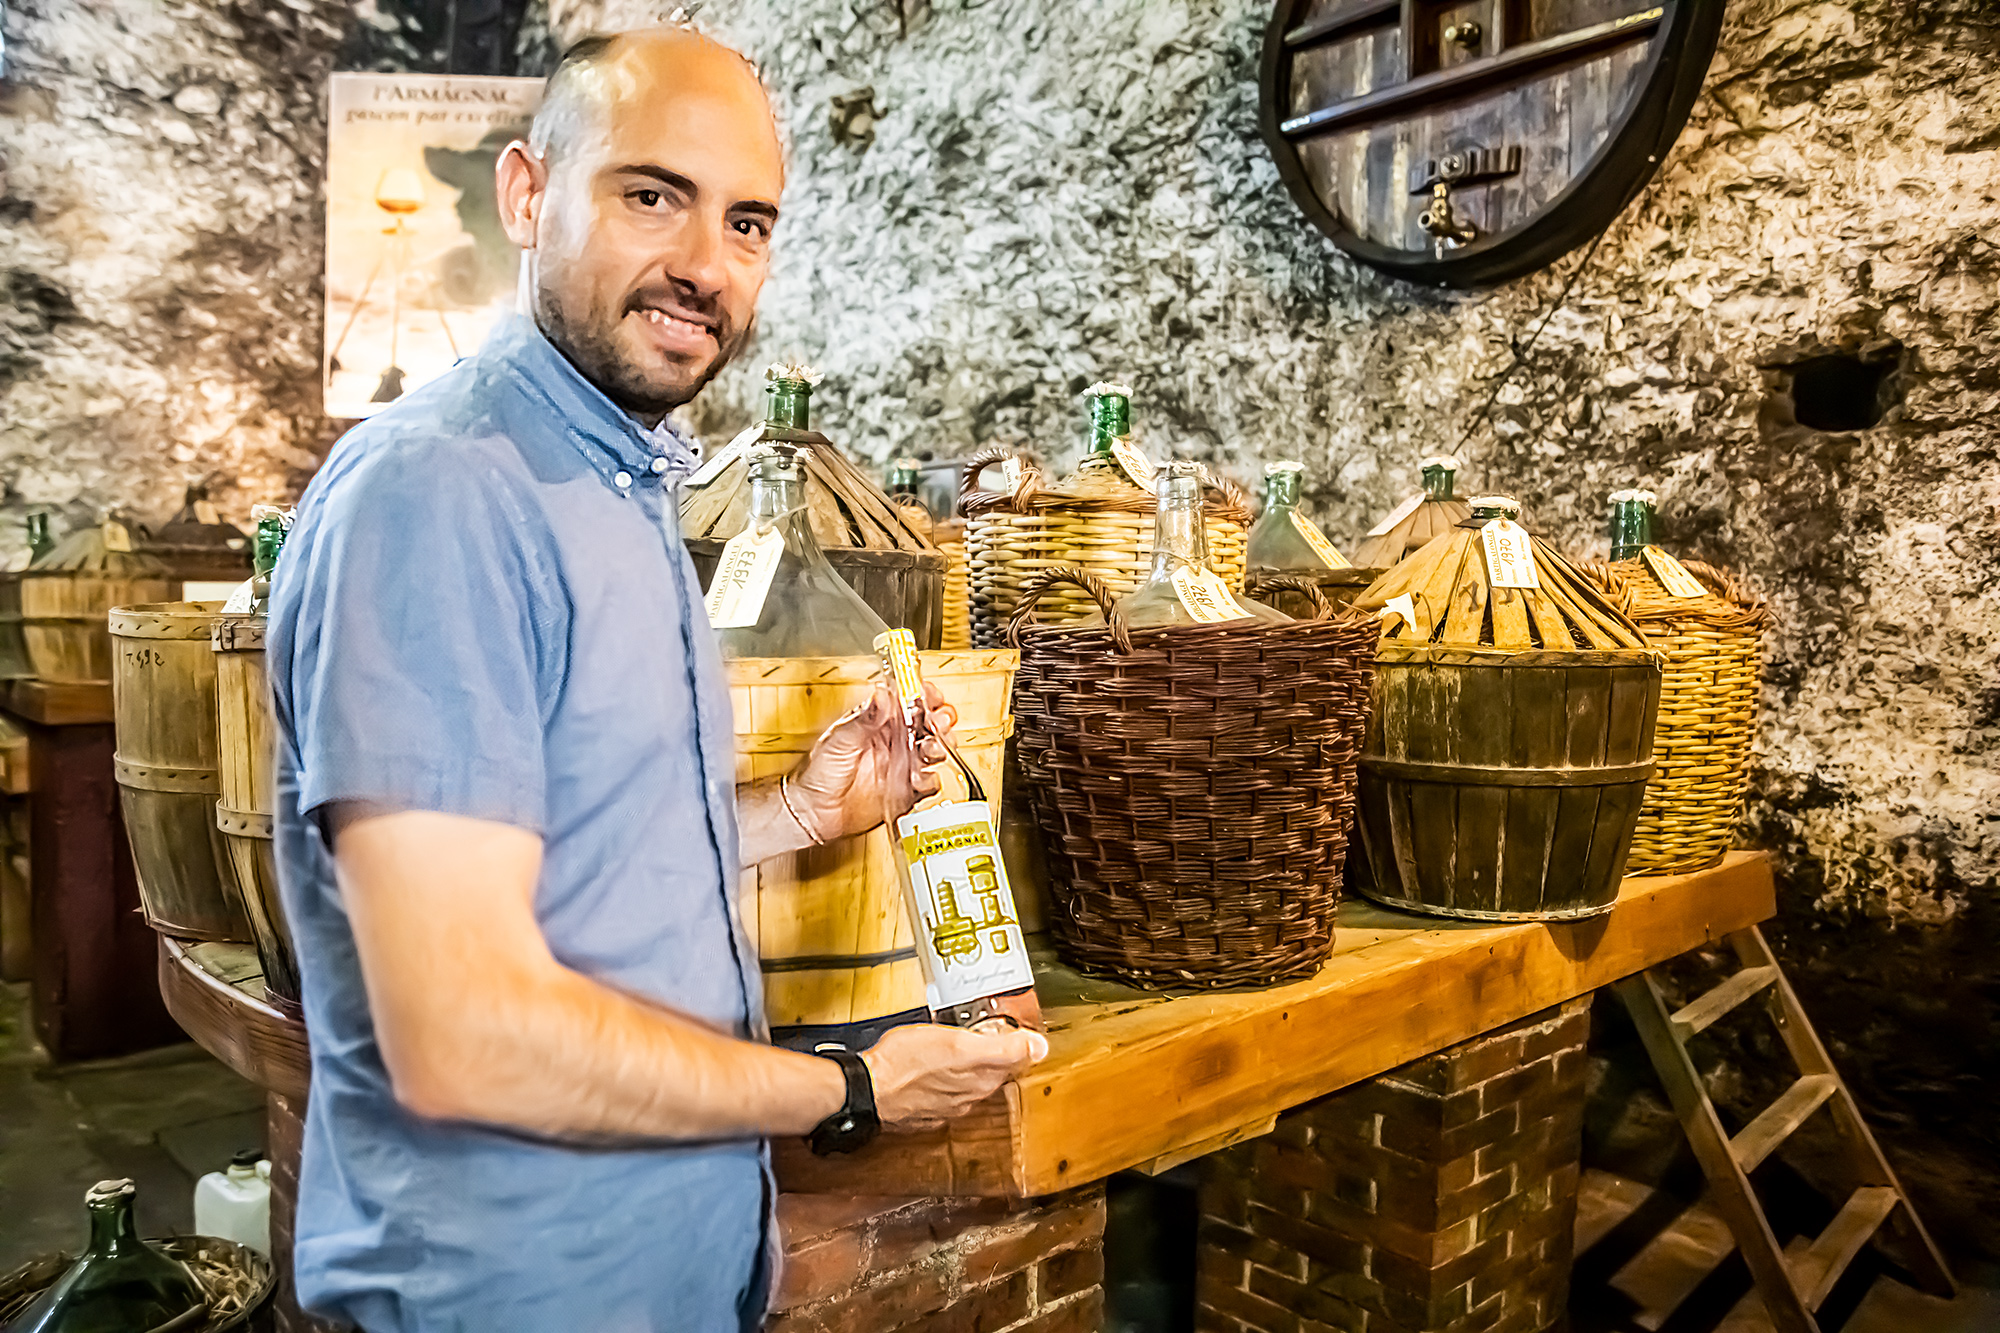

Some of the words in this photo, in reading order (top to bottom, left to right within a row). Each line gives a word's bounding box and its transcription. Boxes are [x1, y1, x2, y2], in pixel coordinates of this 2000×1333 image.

[1499, 538, 1515, 566] 1970
[732, 550, 757, 590] 1973
[1190, 585, 1217, 610] 1972
[917, 832, 988, 857] ARMAGNAC
